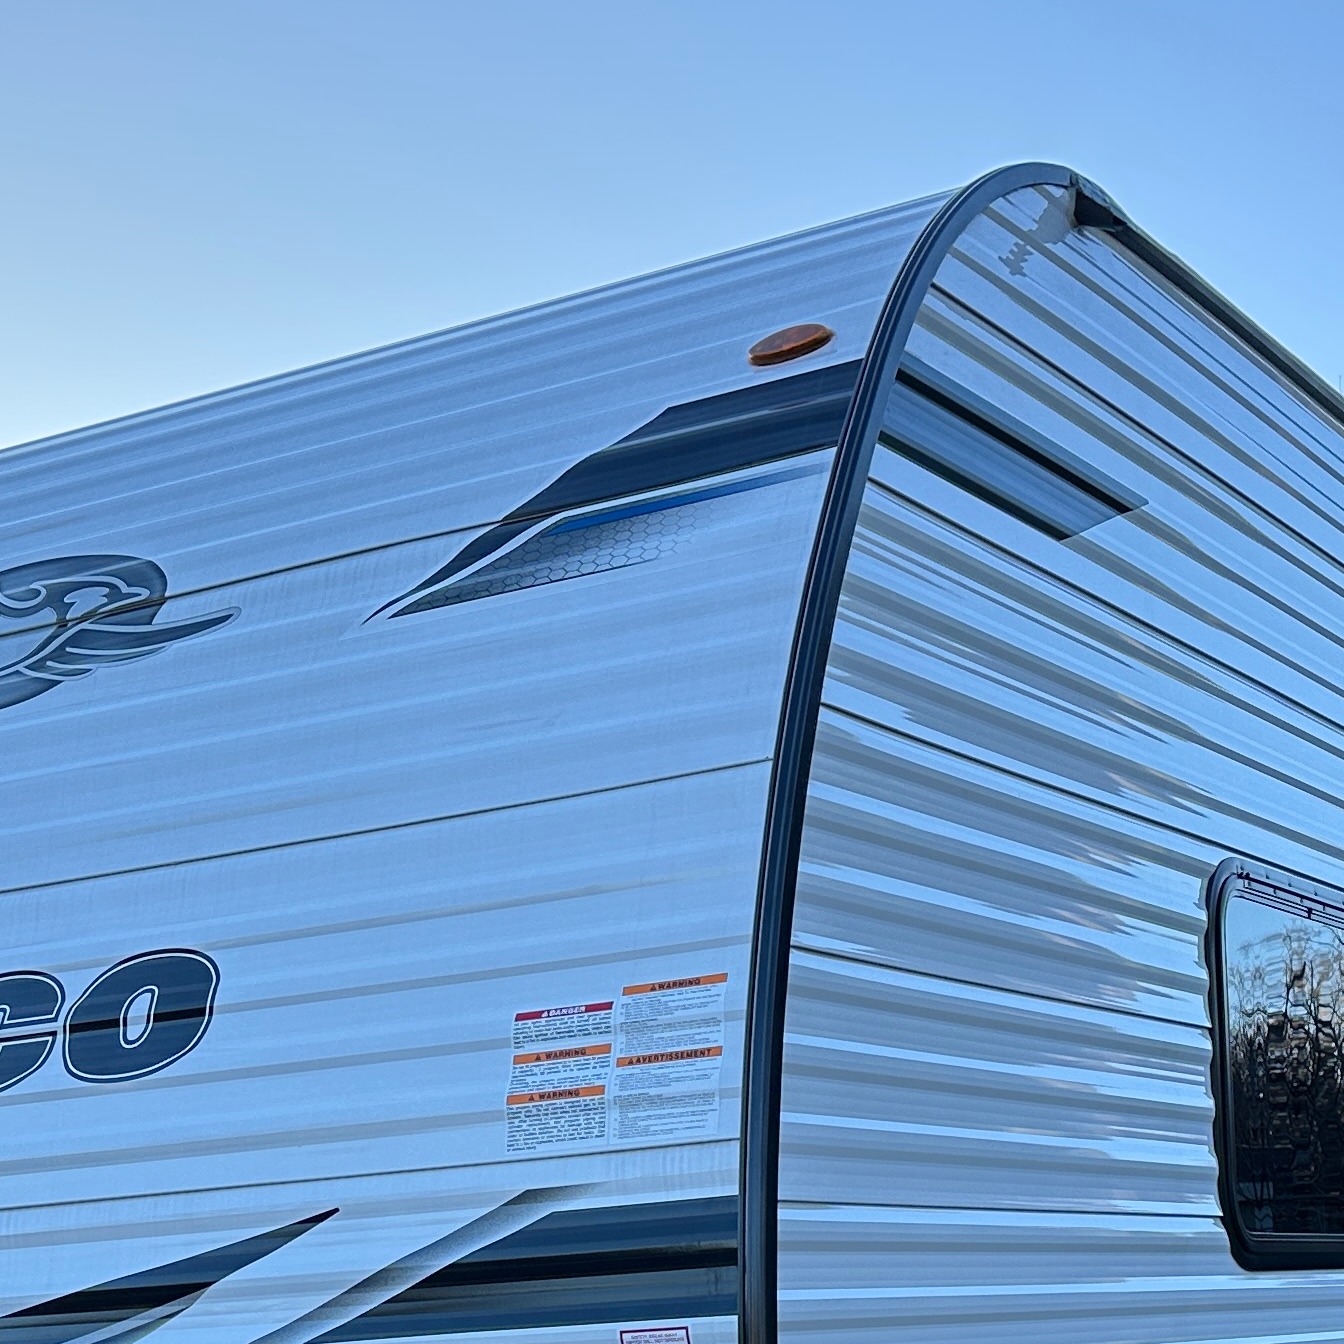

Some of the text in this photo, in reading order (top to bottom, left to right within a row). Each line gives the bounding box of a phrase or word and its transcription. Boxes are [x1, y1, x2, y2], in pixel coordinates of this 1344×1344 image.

[658, 978, 701, 990] WARNING
[549, 1006, 586, 1017] DANGER
[545, 1048, 587, 1060] WARNING
[636, 1048, 712, 1065] AVERTISSEMENT
[538, 1089, 581, 1100] WARNING
